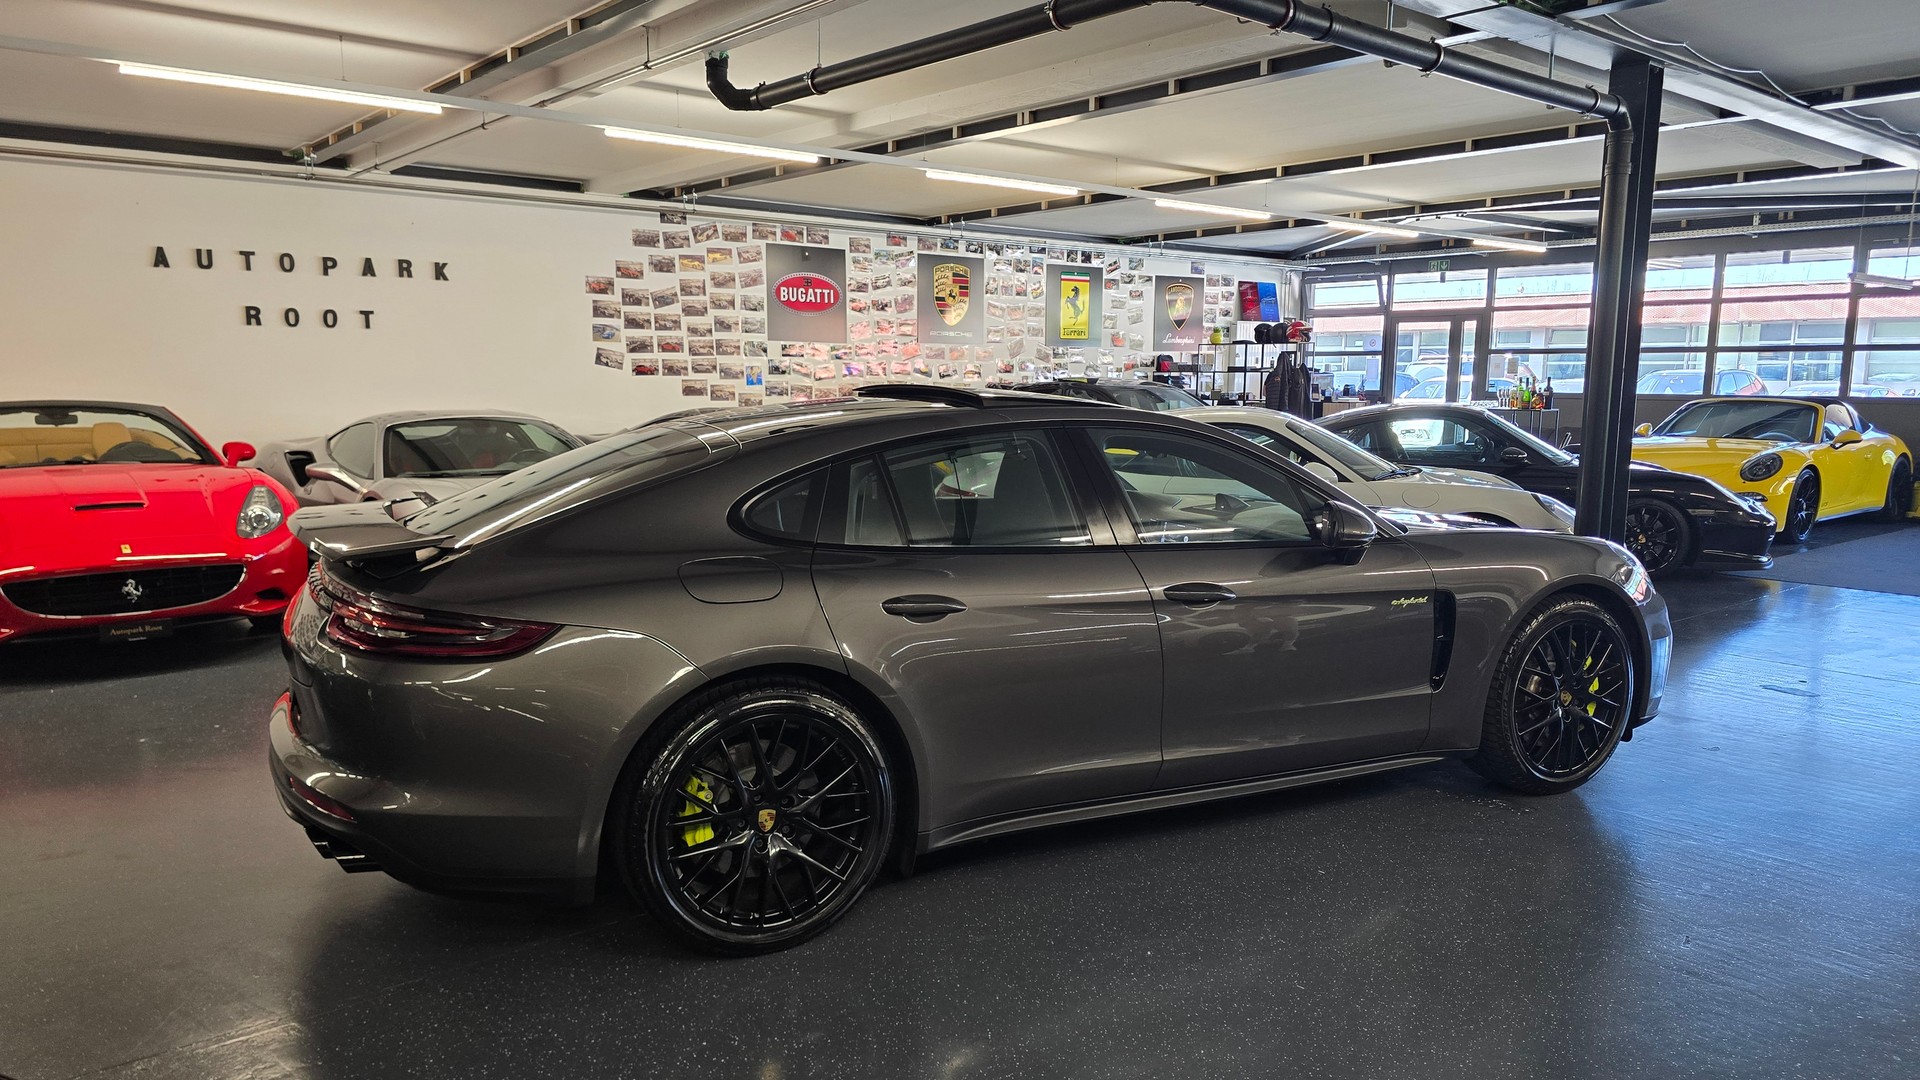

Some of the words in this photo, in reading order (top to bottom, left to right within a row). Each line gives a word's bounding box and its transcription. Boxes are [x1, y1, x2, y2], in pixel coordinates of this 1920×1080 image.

[153, 246, 449, 281] AUTOPARK
[780, 286, 834, 304] BUGATTI
[245, 305, 374, 329] ROOT
[1062, 327, 1086, 336] Ferrari
